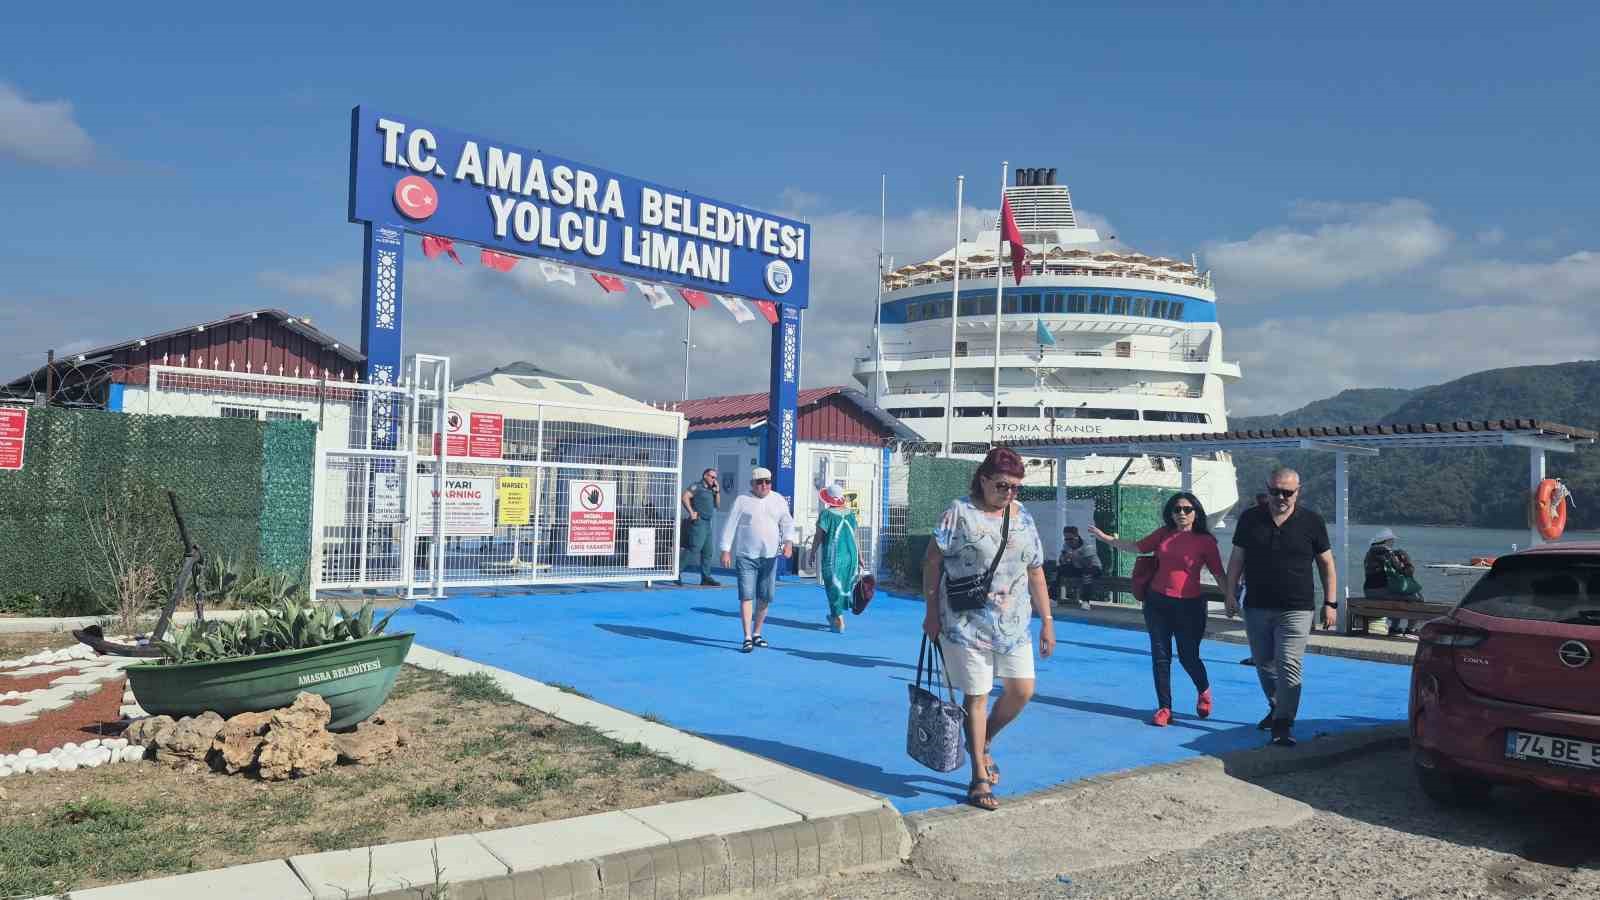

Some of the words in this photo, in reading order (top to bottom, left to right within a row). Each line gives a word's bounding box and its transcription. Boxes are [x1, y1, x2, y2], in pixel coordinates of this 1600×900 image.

[379, 118, 446, 176] T.C.
[455, 140, 624, 218] AMASRA
[641, 187, 804, 261] BELEDİYESİ
[489, 194, 607, 256] YOLCU
[623, 226, 730, 283] LİMANI
[984, 423, 1041, 432] ASTORIA
[445, 480, 472, 489] YARI
[431, 490, 481, 499] WRNING
[298, 671, 332, 686] AMASRA
[1518, 735, 1545, 756] 74
[1551, 740, 1581, 762] BE
